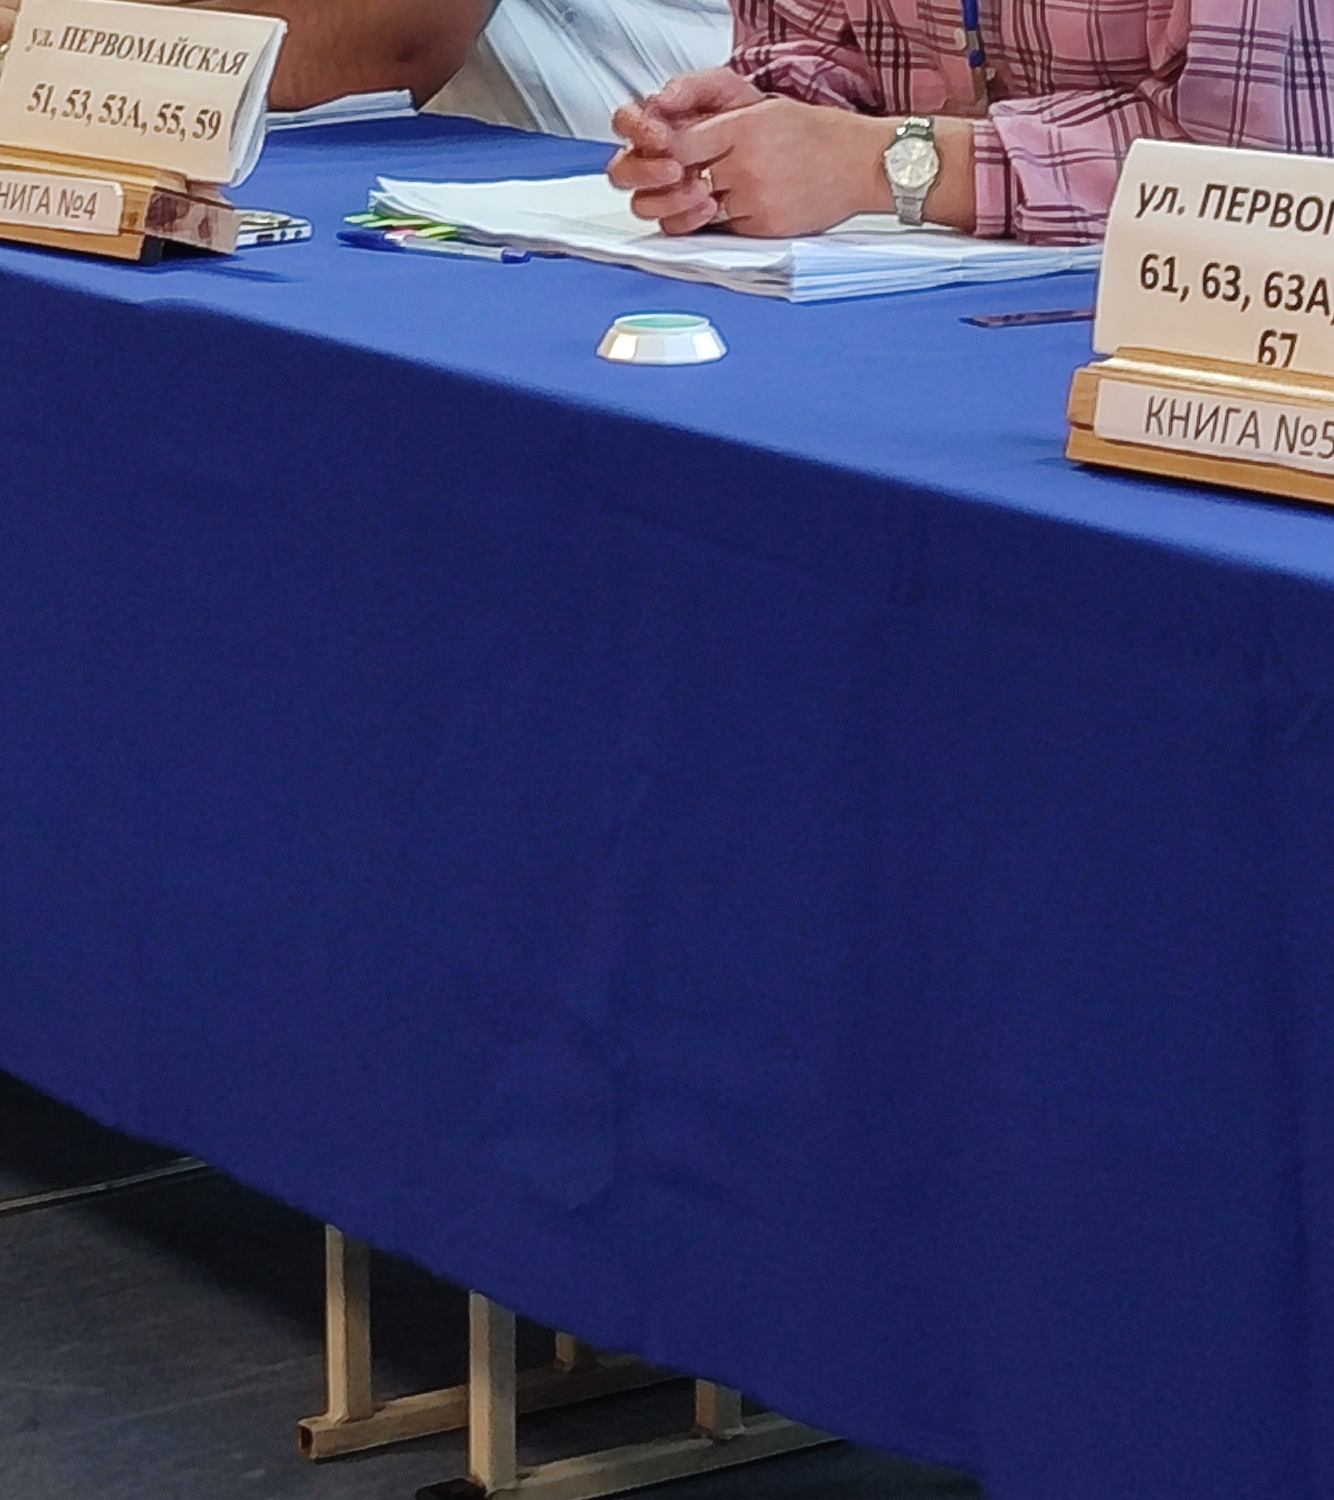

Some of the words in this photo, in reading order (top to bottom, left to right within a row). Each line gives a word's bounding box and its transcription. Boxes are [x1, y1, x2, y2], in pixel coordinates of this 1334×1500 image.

[25, 27, 54, 53] ул.
[58, 26, 251, 76] ПЕРВОМАЙСКАЯ
[26, 83, 58, 117] 51,
[62, 88, 93, 122] 53,
[98, 94, 147, 135] 53А,
[154, 102, 186, 141] 55,
[192, 109, 222, 141] 59
[58, 188, 98, 220] №4
[1136, 182, 1186, 218] ул.
[1140, 253, 1190, 301] 61,
[1202, 263, 1251, 312] 63,
[1258, 329, 1298, 368] 67
[1145, 396, 1260, 449] КНИГА
